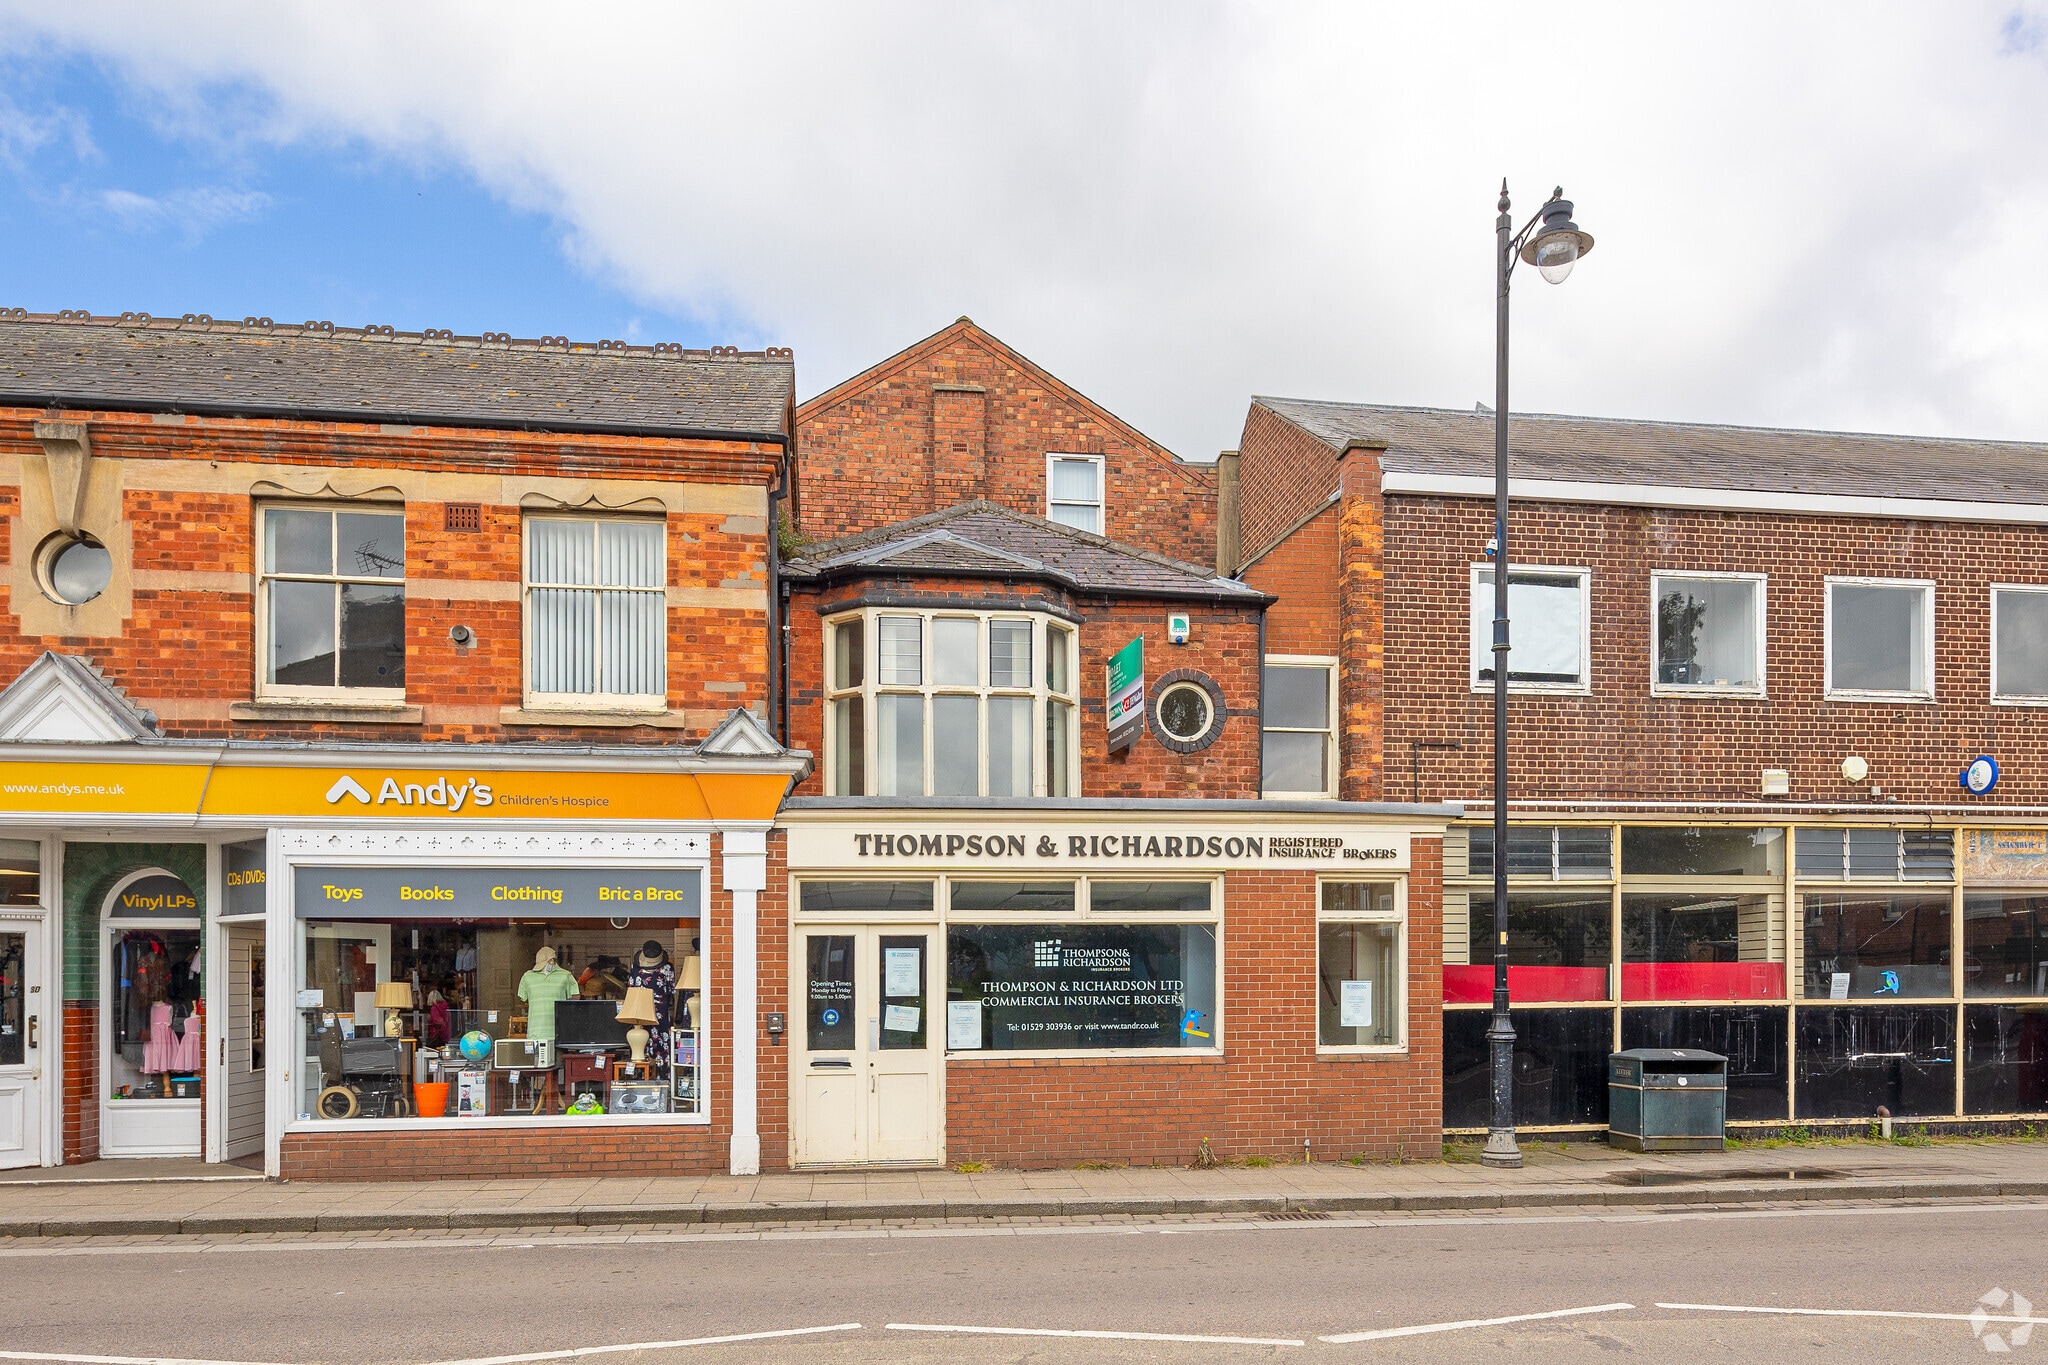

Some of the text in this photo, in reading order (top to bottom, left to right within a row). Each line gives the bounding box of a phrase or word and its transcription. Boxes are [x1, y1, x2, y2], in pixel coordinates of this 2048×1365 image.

[3, 783, 125, 796] www.andys.me.uk
[377, 777, 609, 812] Andy's Children's Hospice
[854, 833, 1264, 858] THOMPSON & RICHARDSON
[1269, 837, 1343, 848] REGISTERED
[1269, 848, 1397, 860] INSURANCE BROKERS
[322, 885, 363, 902] Toys
[400, 886, 454, 900] Books
[491, 886, 563, 904] Clothing
[599, 886, 684, 901] Bric a Brac
[122, 894, 196, 911] Vinyl LPs
[1063, 957, 1131, 967] RICHARDSON
[811, 980, 835, 988] Opening
[981, 980, 1184, 992] THOMPSON & RICHARDSON LTD
[981, 995, 1184, 1006] COMMERCIAL INSURANCE BROKERS
[1006, 1023, 1019, 1031] Tel:
[1021, 1023, 1044, 1031] 01529
[1046, 1023, 1072, 1031] 303936
[1101, 1022, 1159, 1030] www.tandr.co.uk
